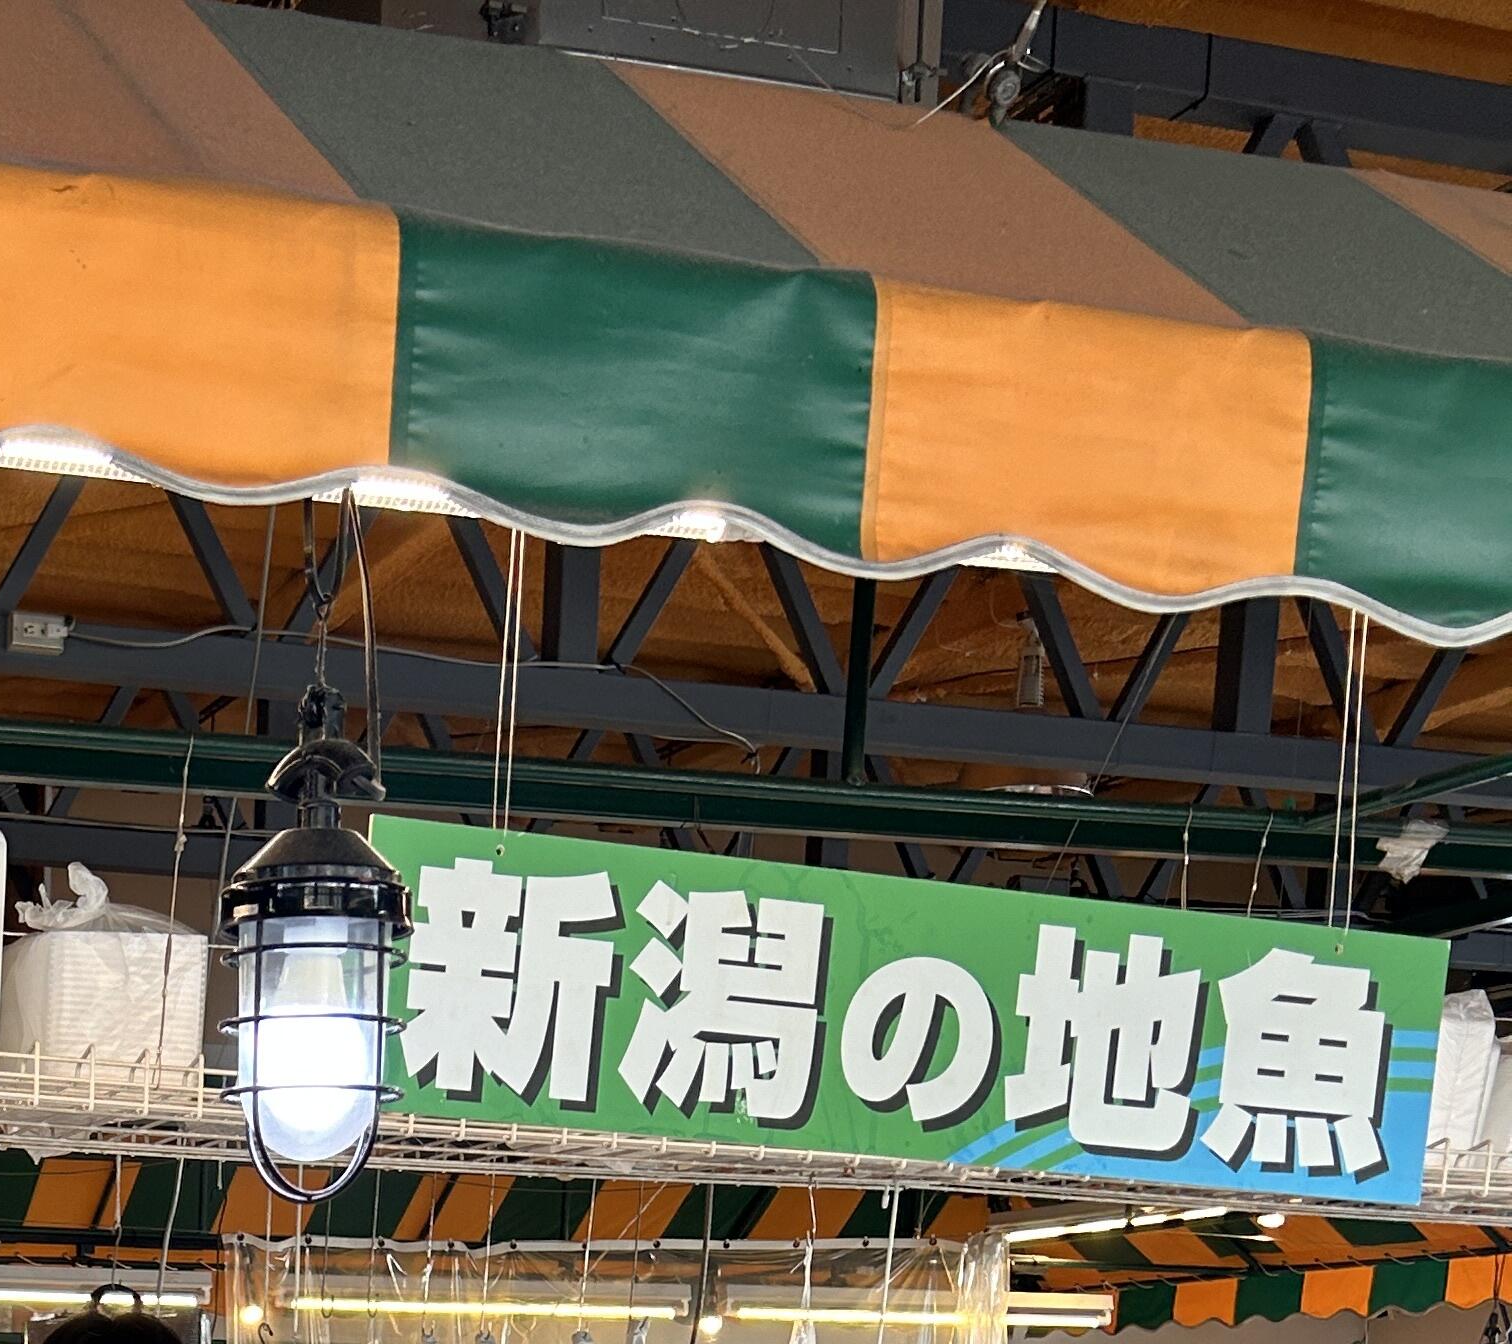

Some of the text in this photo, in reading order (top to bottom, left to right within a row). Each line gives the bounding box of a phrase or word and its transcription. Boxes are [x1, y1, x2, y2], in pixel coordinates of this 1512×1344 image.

[398, 856, 1390, 1182] 新潟の地魚
